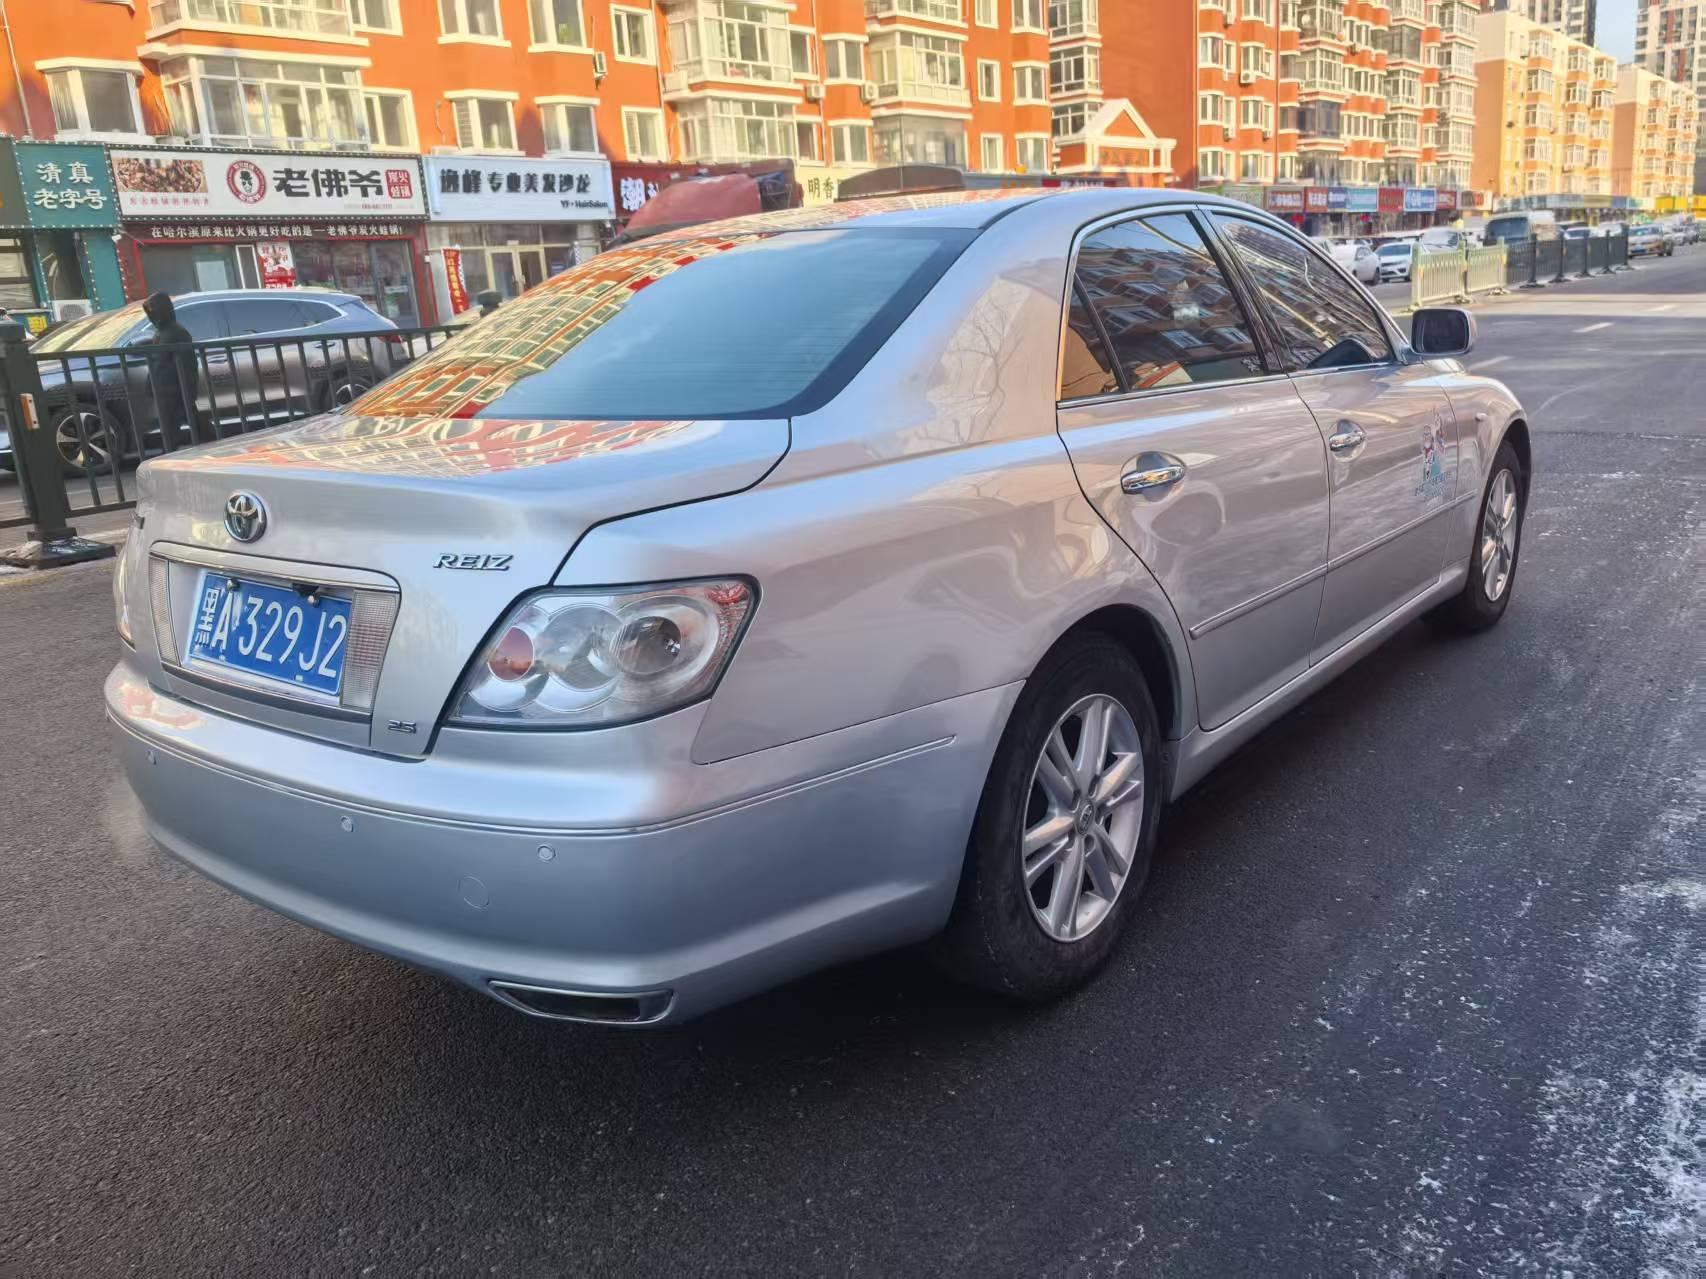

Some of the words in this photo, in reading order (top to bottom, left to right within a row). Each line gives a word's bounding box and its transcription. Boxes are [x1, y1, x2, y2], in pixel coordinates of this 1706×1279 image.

[36, 161, 94, 184] 清真
[272, 167, 384, 198] 老佛爷
[488, 171, 592, 194] 专业美发沙龙
[33, 188, 107, 210] 老字号
[433, 554, 514, 571] REIZ
